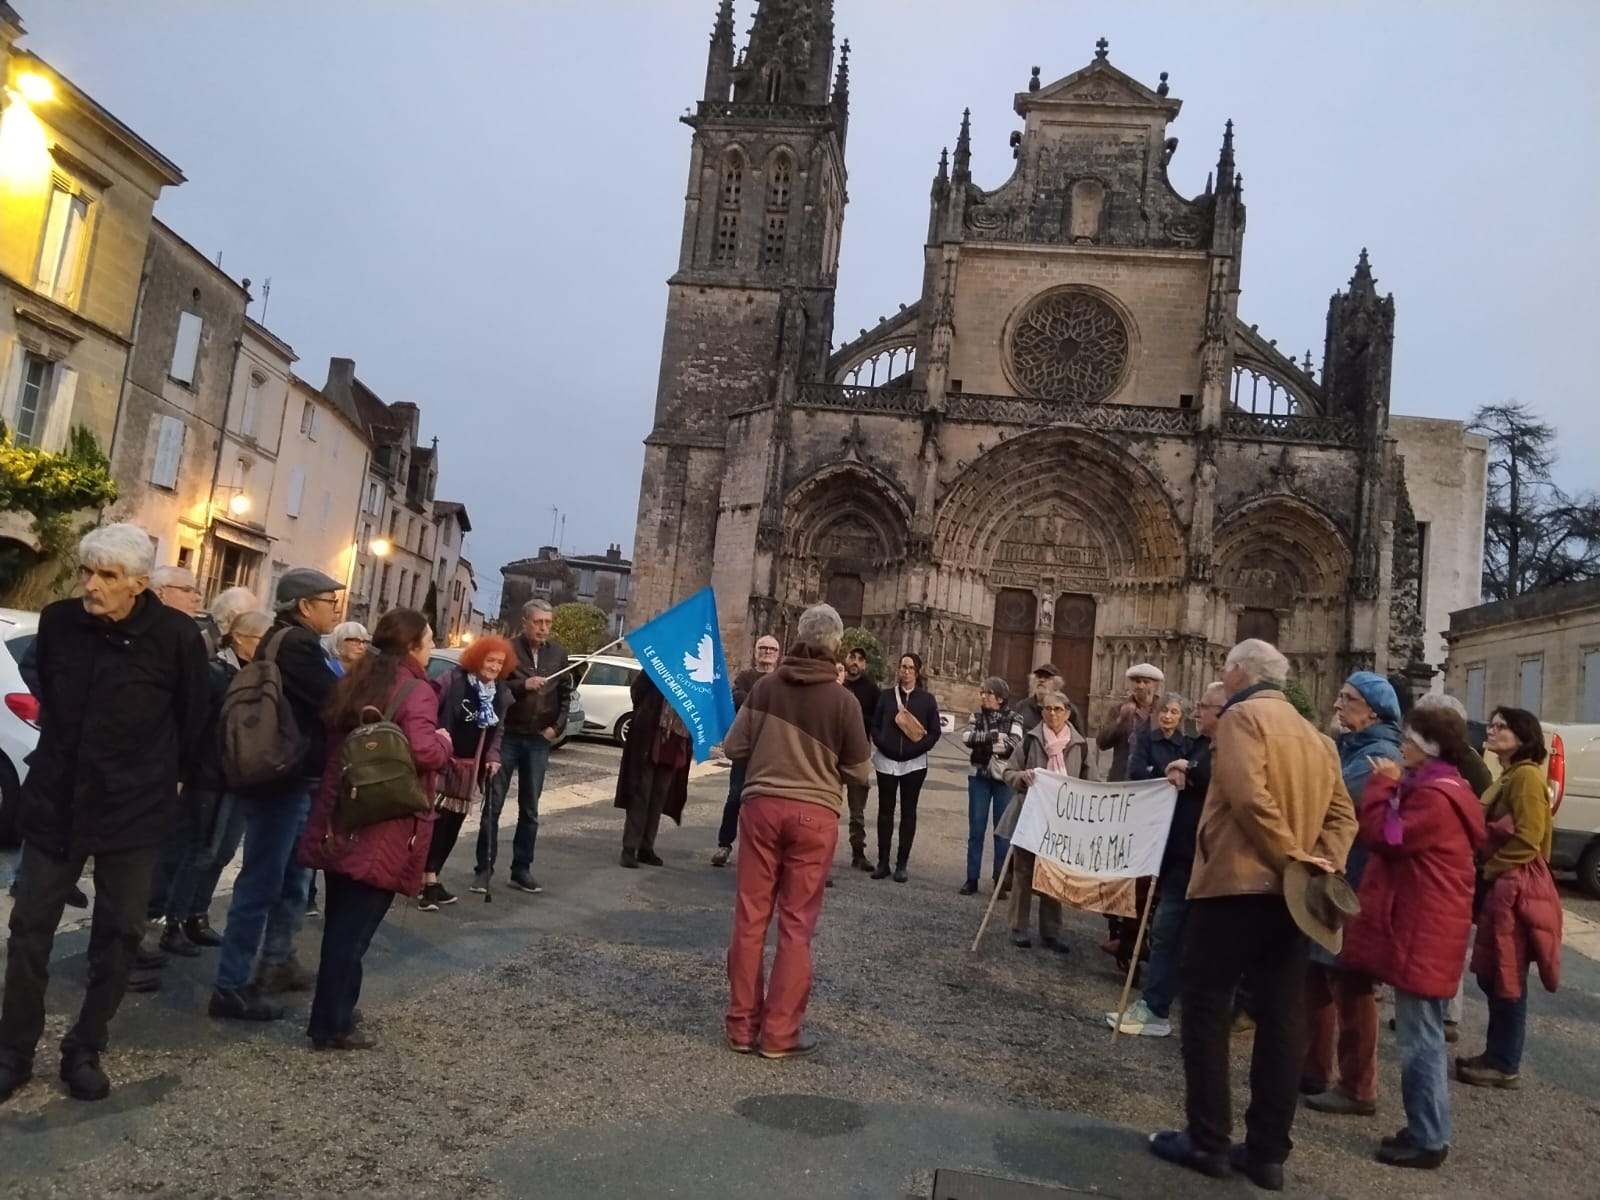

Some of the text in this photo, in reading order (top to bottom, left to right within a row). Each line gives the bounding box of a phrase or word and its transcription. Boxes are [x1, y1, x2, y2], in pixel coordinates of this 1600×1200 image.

[643, 645, 655, 657] LE
[650, 656, 688, 700] MOUVEMENT
[682, 699, 695, 712] DE
[690, 711, 702, 724] LA
[1056, 782, 1136, 823] COLLECTIF
[1038, 821, 1071, 865] APPEL
[1089, 835, 1103, 872] 18
[1106, 833, 1134, 870] MAI
